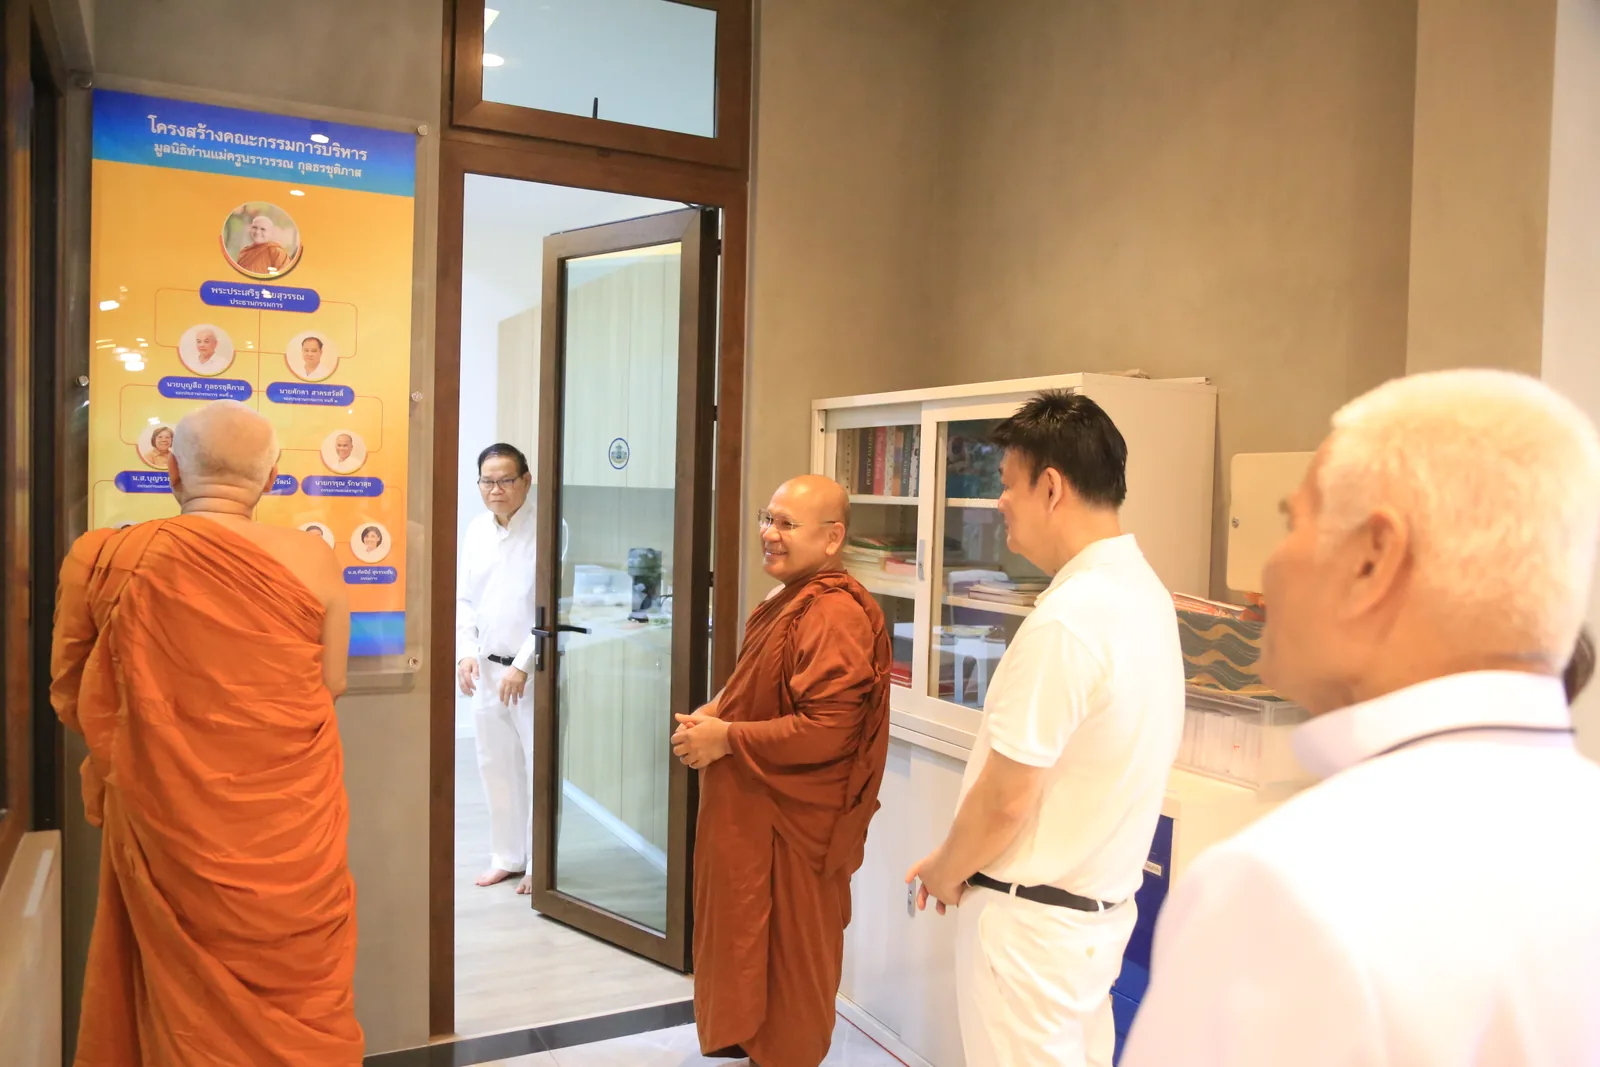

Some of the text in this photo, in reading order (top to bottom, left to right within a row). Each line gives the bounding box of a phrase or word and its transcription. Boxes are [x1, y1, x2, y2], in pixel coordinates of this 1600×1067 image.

[147, 114, 368, 161] โครงสร้างคณะกรรมการบริหาร
[153, 142, 363, 179] มูลนิธิท่านแม่ครูนราวรรณ กุลธรชุติภาส
[210, 286, 305, 301] พระประเสริฐ ยสุวรรณ
[229, 298, 284, 309] ประธานกรรมการ
